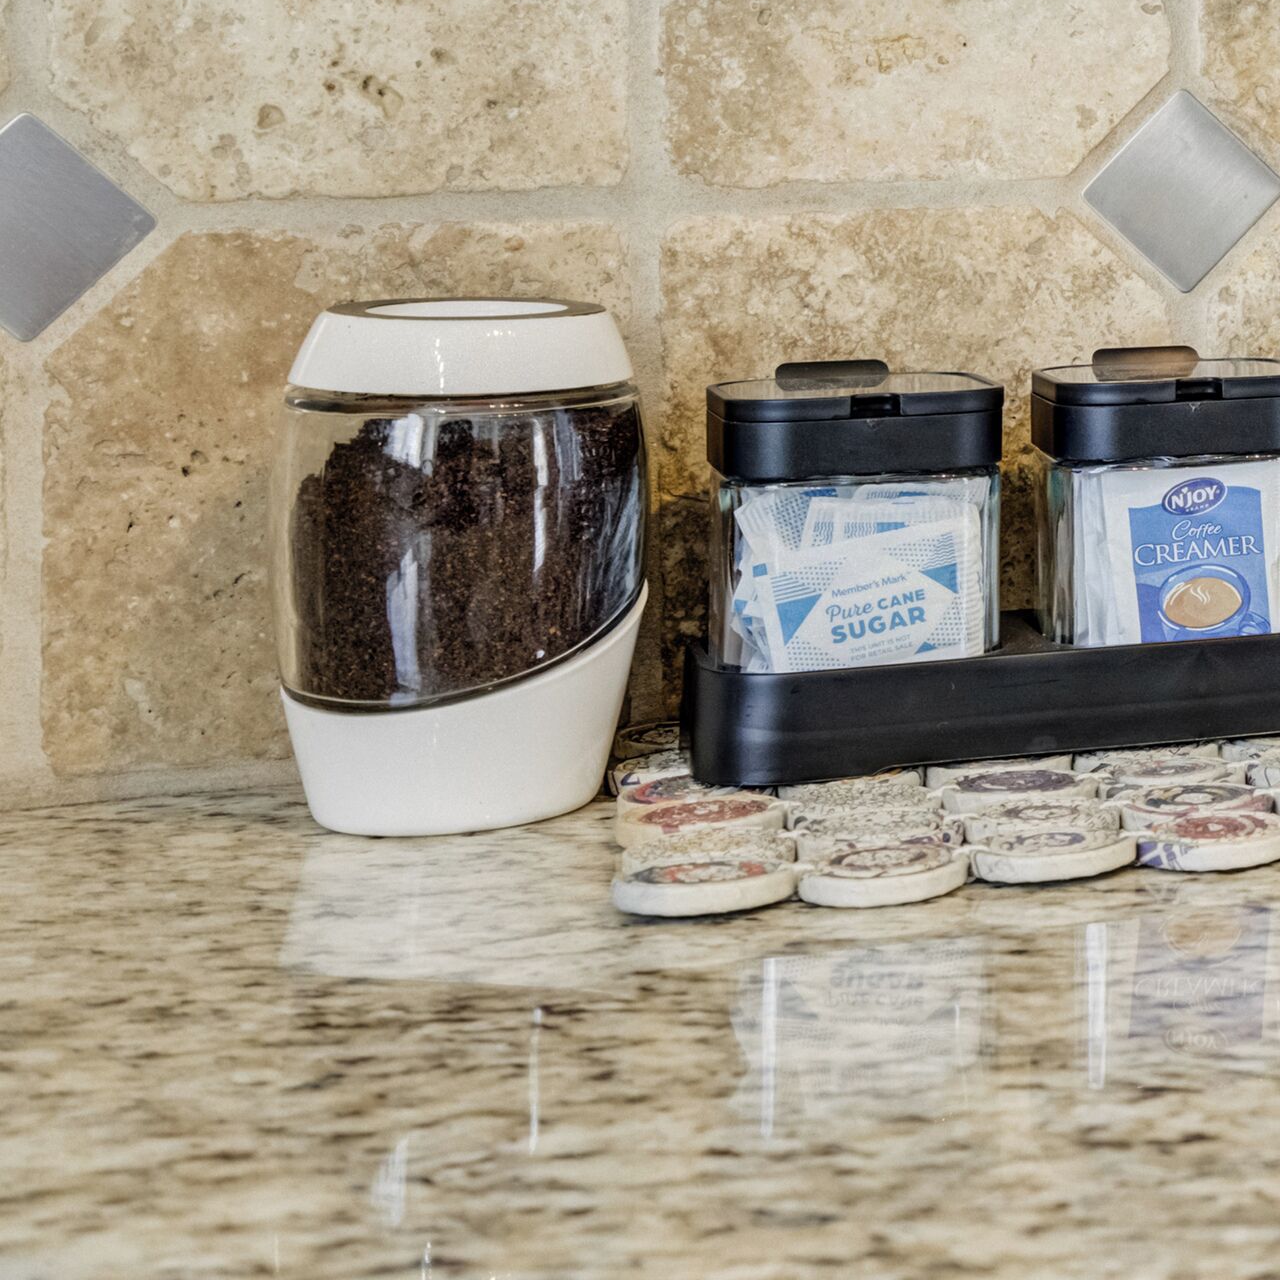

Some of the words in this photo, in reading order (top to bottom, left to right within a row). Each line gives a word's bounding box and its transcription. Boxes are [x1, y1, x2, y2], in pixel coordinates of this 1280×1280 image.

[1172, 519, 1222, 541] Coffee
[1134, 535, 1261, 566] CREAMER
[831, 580, 881, 598] Member's
[881, 574, 907, 587] Mark
[825, 602, 873, 623] Pure
[877, 588, 926, 610] CANE
[831, 606, 927, 644] SUGAR
